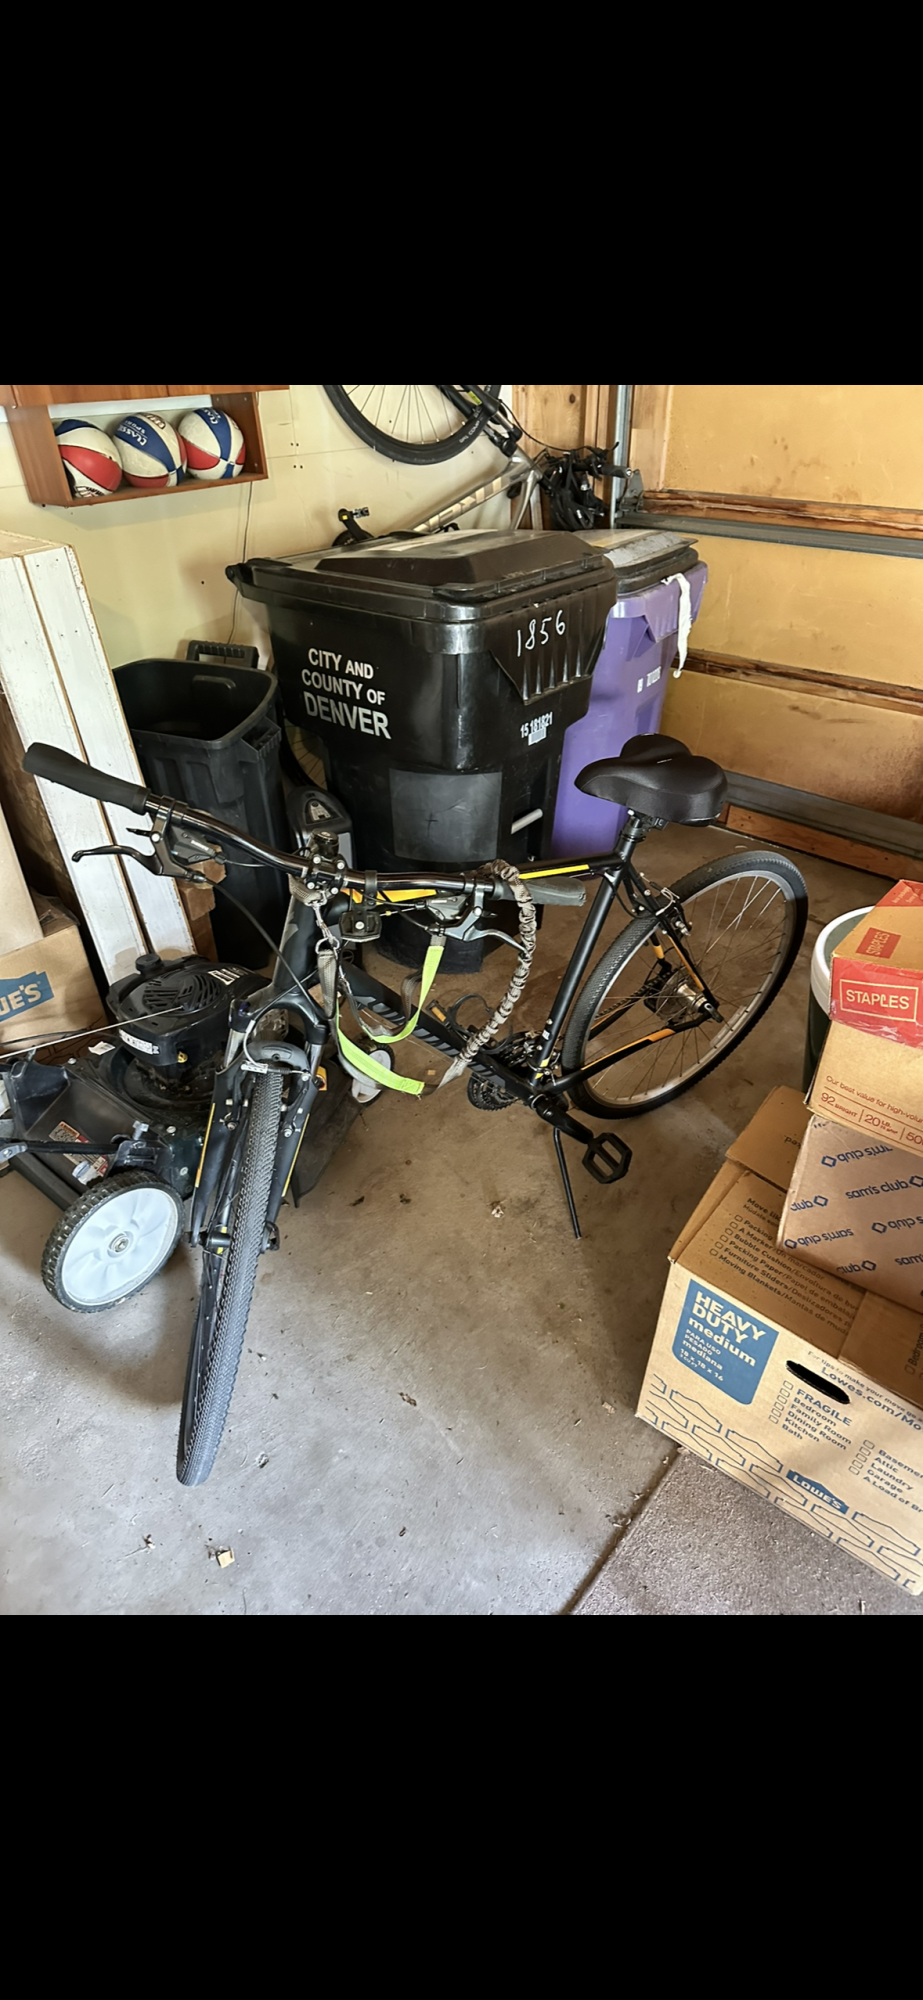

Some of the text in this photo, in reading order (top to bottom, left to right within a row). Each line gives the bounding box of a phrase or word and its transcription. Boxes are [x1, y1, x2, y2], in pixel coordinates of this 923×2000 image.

[517, 609, 566, 657] 1856
[308, 647, 374, 680] CITY AND
[301, 668, 386, 706] COUNTY OF
[303, 690, 392, 740] DENVER
[520, 722, 530, 738] 15
[865, 930, 891, 956] STAPLES
[846, 989, 910, 1010] STAPLES
[820, 1092, 858, 1117] 92 BRIGHT
[826, 1074, 840, 1085] Our
[840, 1082, 855, 1095] best
[856, 1089, 875, 1103] value
[875, 1098, 887, 1108] for
[864, 1114, 881, 1127] 20
[836, 1144, 893, 1163] m's club
[845, 1178, 909, 1200] sam's club
[747, 1198, 782, 1220] Move lik
[887, 1216, 916, 1230] club
[744, 1220, 773, 1241] Packing
[797, 1228, 854, 1247] sam's club
[729, 1240, 759, 1263] Packing
[760, 1259, 808, 1291] Paper/Papel
[809, 1287, 818, 1297] de
[734, 1234, 760, 1253] Bubble
[761, 1250, 832, 1295] Cushion/Envoltura
[833, 1292, 845, 1303] de
[787, 1253, 825, 1281] marcador
[895, 1253, 923, 1266] sam'
[718, 1254, 746, 1276] Moving
[747, 1272, 813, 1316] Blankets/Mantas
[815, 1312, 826, 1322] de
[724, 1247, 759, 1272] Furniture
[760, 1269, 842, 1322] Sliders/Deslizadores
[692, 1302, 749, 1344] DUTY
[695, 1290, 766, 1341] HEAVY
[682, 1339, 723, 1370] mediana
[684, 1334, 713, 1356] PESADO
[685, 1328, 721, 1355] PARA USO
[688, 1317, 756, 1367] medium
[680, 1348, 690, 1357] 18
[697, 1360, 707, 1369] 18
[714, 1371, 724, 1382] 16
[821, 1358, 835, 1371] tips
[844, 1373, 866, 1388] make
[865, 1386, 883, 1398] your
[884, 1397, 906, 1413] move
[906, 1410, 917, 1419] go
[793, 1397, 837, 1427] Bedroom
[796, 1388, 853, 1427] FRAGILE
[782, 1423, 803, 1440] Bath
[784, 1416, 820, 1442] Kitchen
[787, 1410, 847, 1450] Dining Room
[790, 1403, 852, 1445] Family Room
[870, 1461, 914, 1491] Laundry
[874, 1456, 899, 1474] Attic
[792, 1474, 844, 1509] LOWE'S
[863, 1475, 923, 1513] A Load of Br
[866, 1468, 904, 1493] Garage
